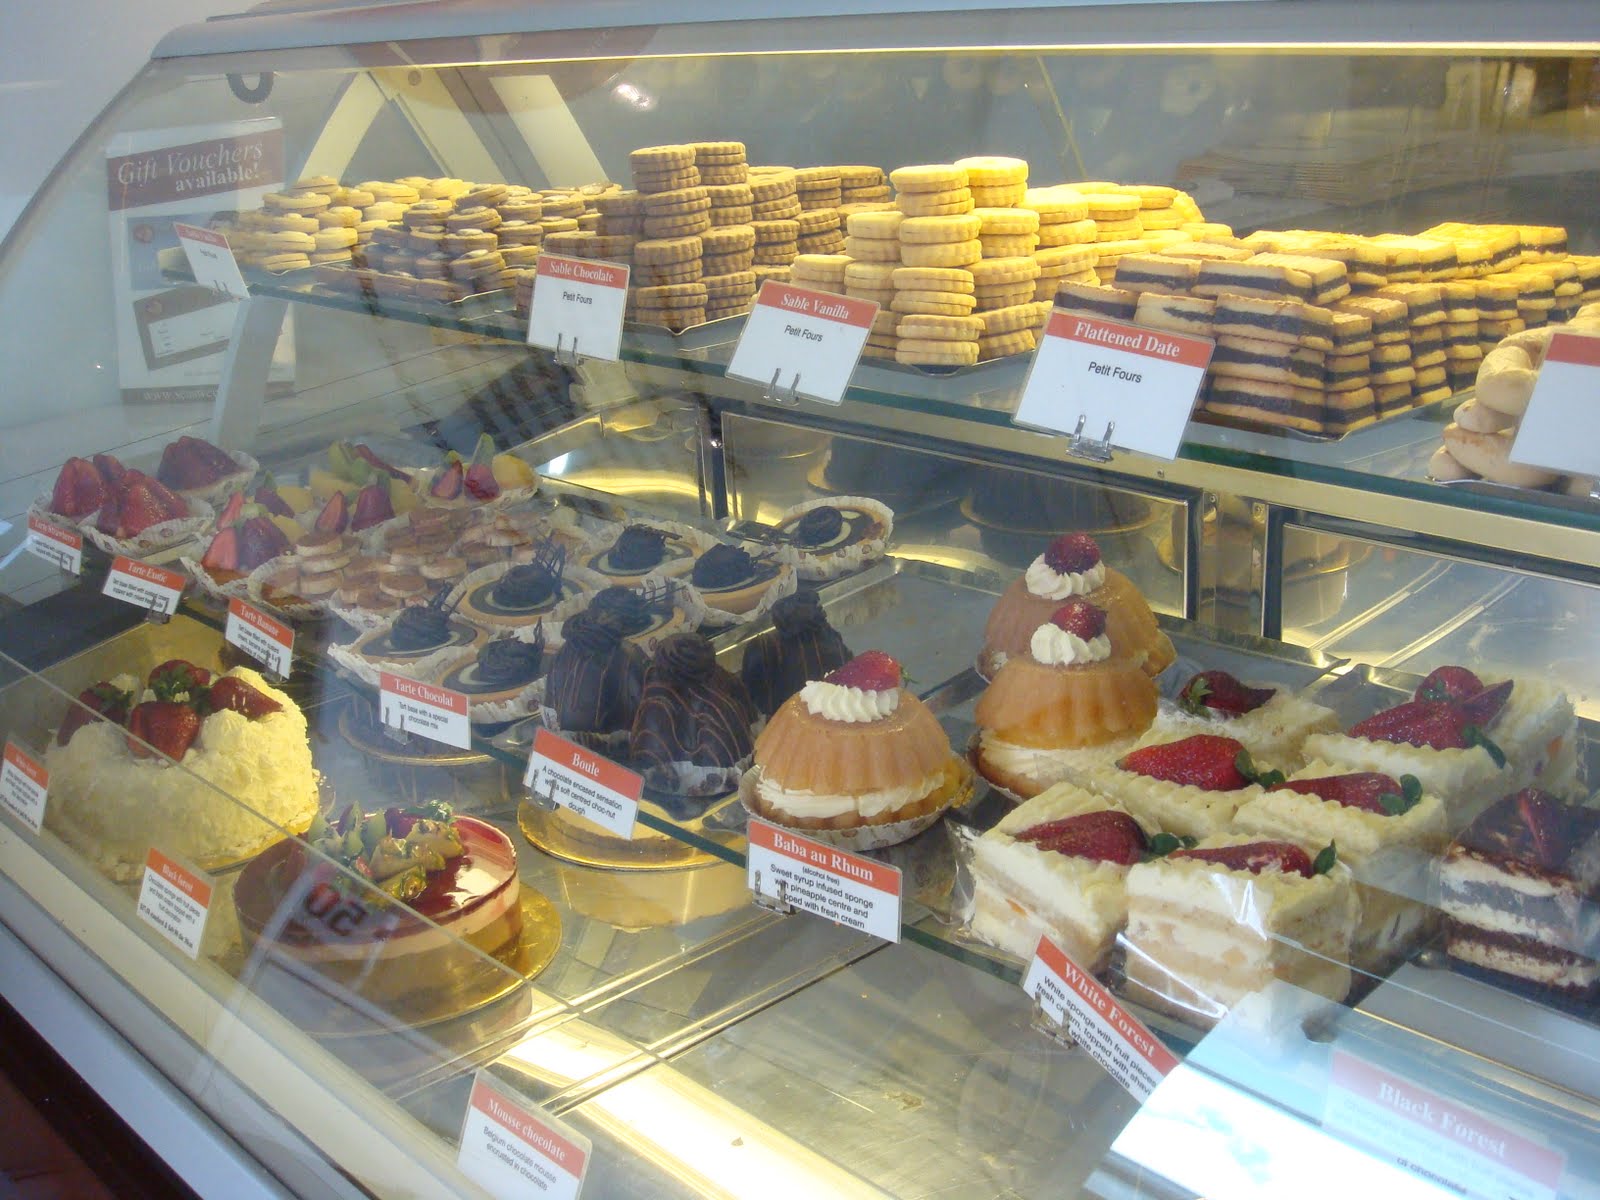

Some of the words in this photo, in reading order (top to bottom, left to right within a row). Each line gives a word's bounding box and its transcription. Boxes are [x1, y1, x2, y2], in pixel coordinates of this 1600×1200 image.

[118, 159, 157, 184] Gift
[167, 143, 264, 175] Vouchers
[175, 162, 260, 192] available!
[550, 261, 572, 275] Sable
[573, 264, 614, 282] Chocolate
[562, 291, 575, 301] Petit
[576, 293, 593, 304] Fours
[781, 293, 810, 310] Sable
[813, 299, 849, 319] Vanilla
[784, 324, 801, 336] Petit
[802, 328, 823, 342] Fours
[1074, 321, 1143, 349] Flattened
[1145, 336, 1180, 357] Date
[1088, 361, 1111, 376] Petit
[1112, 366, 1143, 383] Fours
[128, 561, 147, 576] Tarte
[147, 568, 168, 582] Exotic
[240, 604, 257, 623] Tarte
[394, 678, 417, 695] Tarte
[417, 685, 454, 708] Chocolat
[418, 707, 428, 716] with
[572, 753, 600, 777] Boule
[542, 765, 547, 774] A
[547, 768, 573, 786] chocolate
[572, 781, 596, 798] encased
[596, 793, 623, 811] sensation
[560, 787, 571, 796] soft
[570, 791, 591, 807] centred
[591, 802, 616, 819] choc-nut
[568, 801, 586, 816] dough
[773, 833, 807, 858] Baba
[810, 851, 827, 865] au
[830, 853, 873, 881] Rhum
[770, 863, 793, 879] Sweet
[793, 873, 815, 887] syrup
[816, 880, 843, 898] infused
[844, 891, 874, 909] sponge
[802, 865, 826, 880] (alcohol
[826, 873, 840, 886] free)
[777, 889, 803, 906] tpped
[804, 900, 820, 911] with
[820, 905, 839, 919] fresh
[841, 914, 865, 929] cream
[790, 884, 826, 903] pineapple
[828, 895, 852, 912] centre
[853, 906, 869, 919] and
[1064, 962, 1106, 1010] White
[1107, 1006, 1155, 1058] Forest
[1036, 981, 1055, 1005] fresh
[1055, 1002, 1082, 1031] crm,
[1083, 1026, 1112, 1058] topped
[1113, 1054, 1129, 1075] with
[1130, 1074, 1152, 1096] shavi
[1044, 975, 1066, 1001] White
[1066, 998, 1096, 1030] sponge
[1097, 1026, 1113, 1046] with
[1114, 1039, 1130, 1062] fruit
[1130, 1060, 1157, 1088] pieces
[1071, 1030, 1092, 1052] white
[1092, 1050, 1131, 1089] chocolate
[488, 1099, 521, 1131] Mousse
[522, 1125, 566, 1161] chocolate
[1376, 1082, 1434, 1123] Black
[1438, 1110, 1507, 1158] Forest
[483, 1126, 506, 1147] Belgium
[506, 1142, 534, 1167] chocolate
[534, 1163, 557, 1183] mousse
[486, 1143, 514, 1167] encrusted
[514, 1161, 520, 1171] in
[520, 1166, 548, 1191] chocolate
